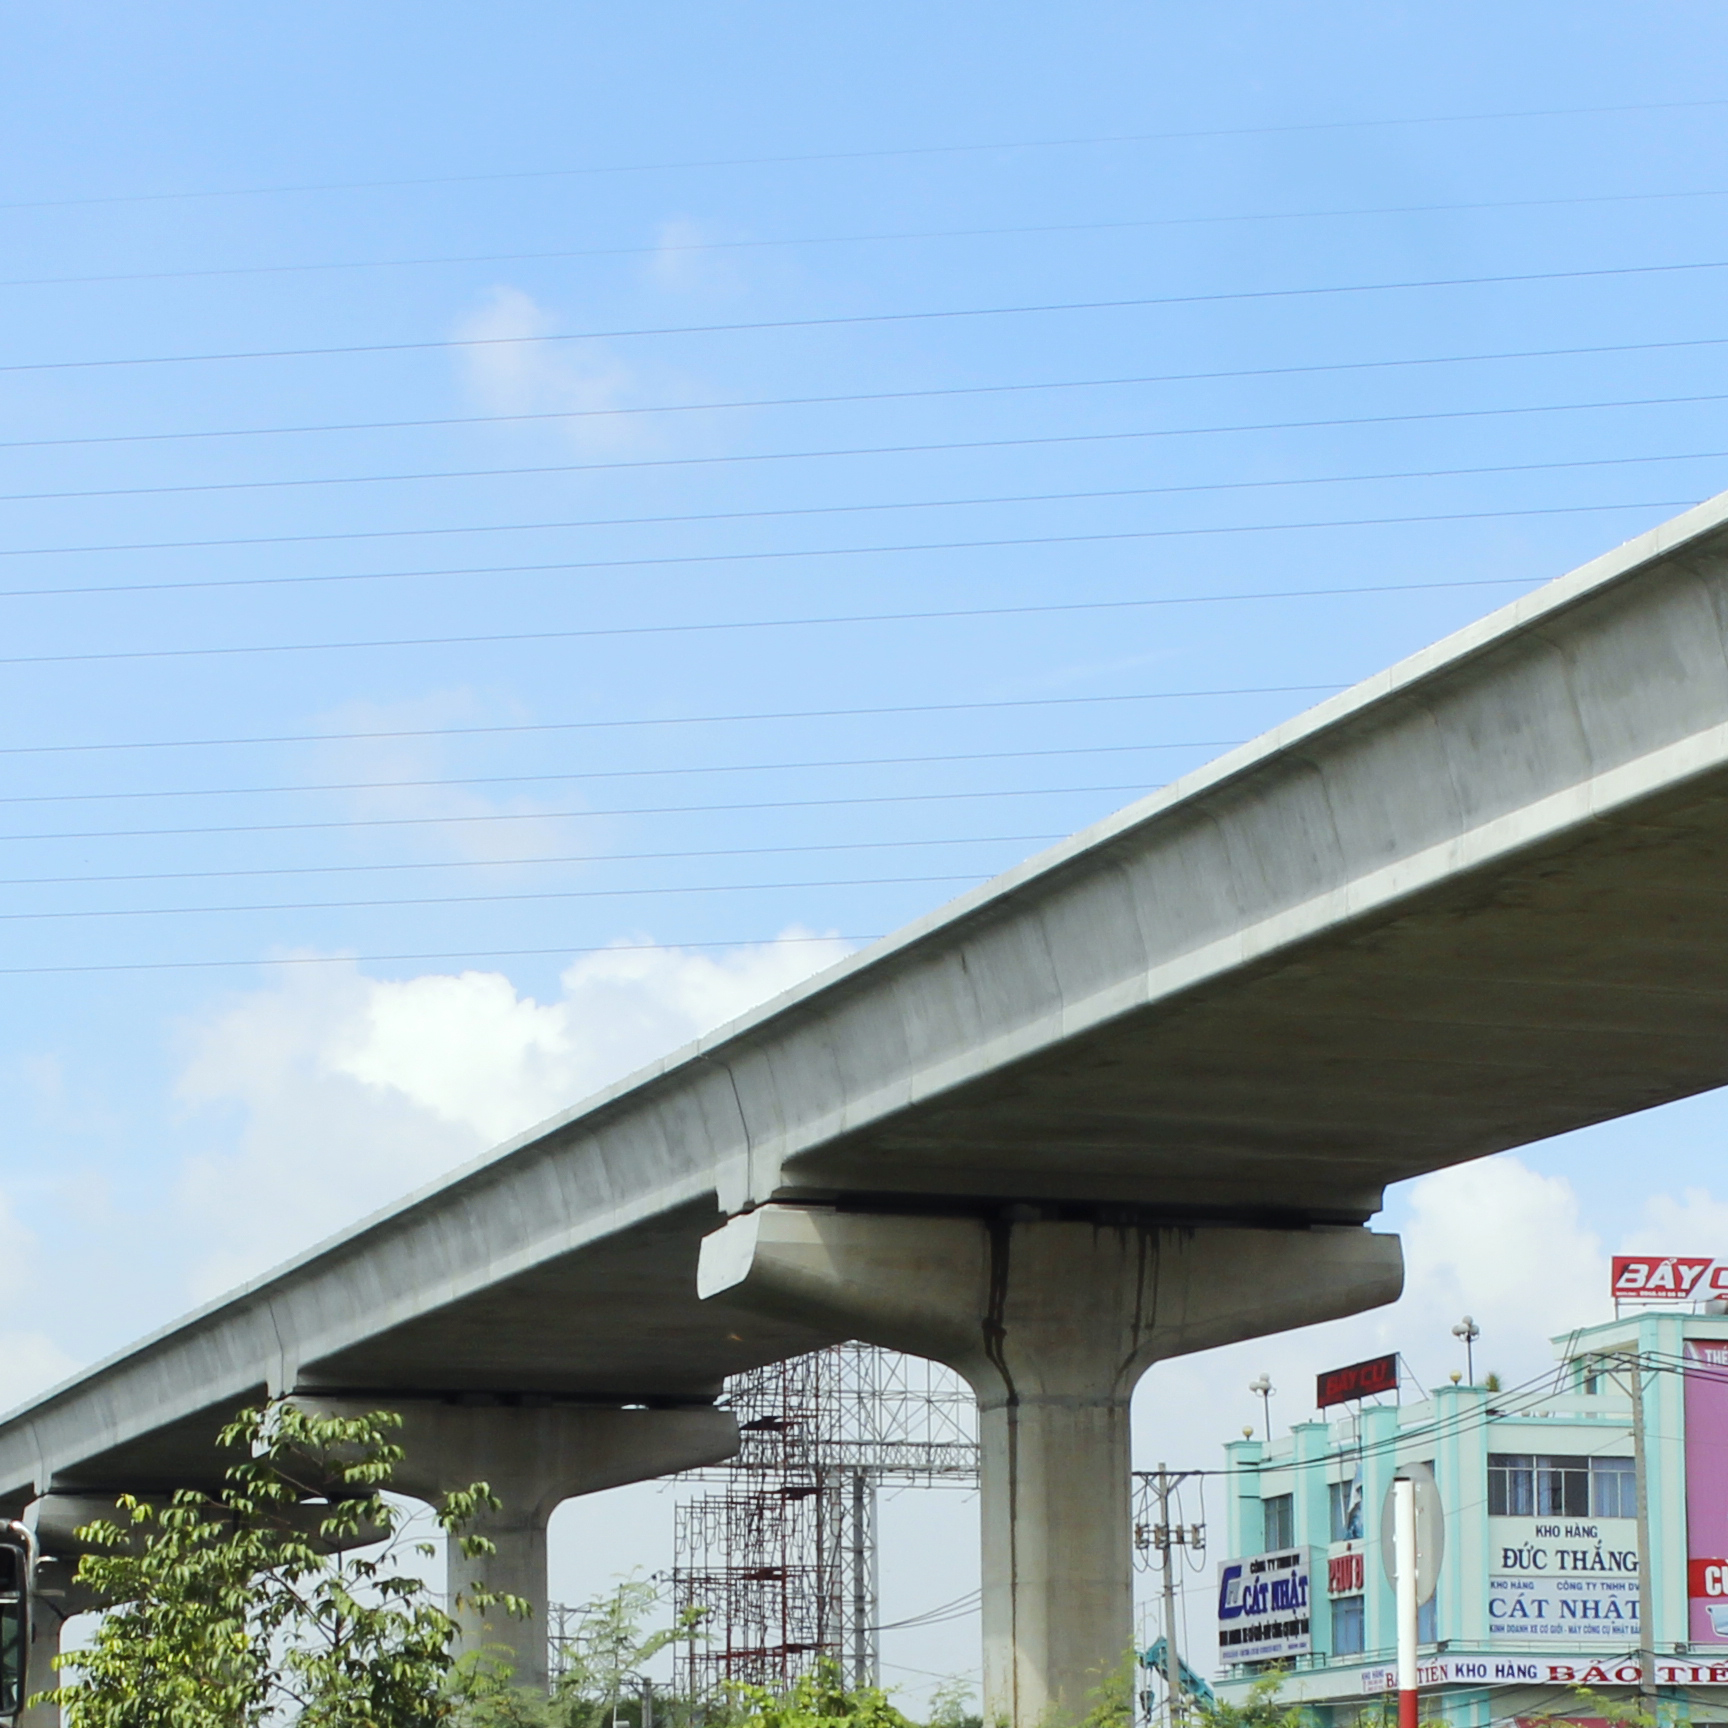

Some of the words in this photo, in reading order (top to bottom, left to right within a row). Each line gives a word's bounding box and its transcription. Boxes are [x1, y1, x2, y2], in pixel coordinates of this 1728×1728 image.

[1536, 1525, 1561, 1538] KHO
[1565, 1522, 1598, 1538] HÀNG
[1502, 1540, 1547, 1570] ĐỨC
[1555, 1539, 1639, 1572] THẮNG
[1243, 1576, 1269, 1617] CÁT
[1271, 1569, 1308, 1615] NHẬT
[1491, 1581, 1508, 1589] KHO
[1511, 1579, 1534, 1590] HÀNG
[1557, 1579, 1583, 1590] CÔNG
[1585, 1582, 1597, 1591] TY
[1600, 1582, 1626, 1591] TNHH
[1489, 1592, 1550, 1619] CÁT
[1559, 1594, 1640, 1624] NHẬT
[1455, 1663, 1487, 1679] KHO
[1495, 1660, 1537, 1679] HÀNG
[1546, 1659, 1643, 1682] BẢO
